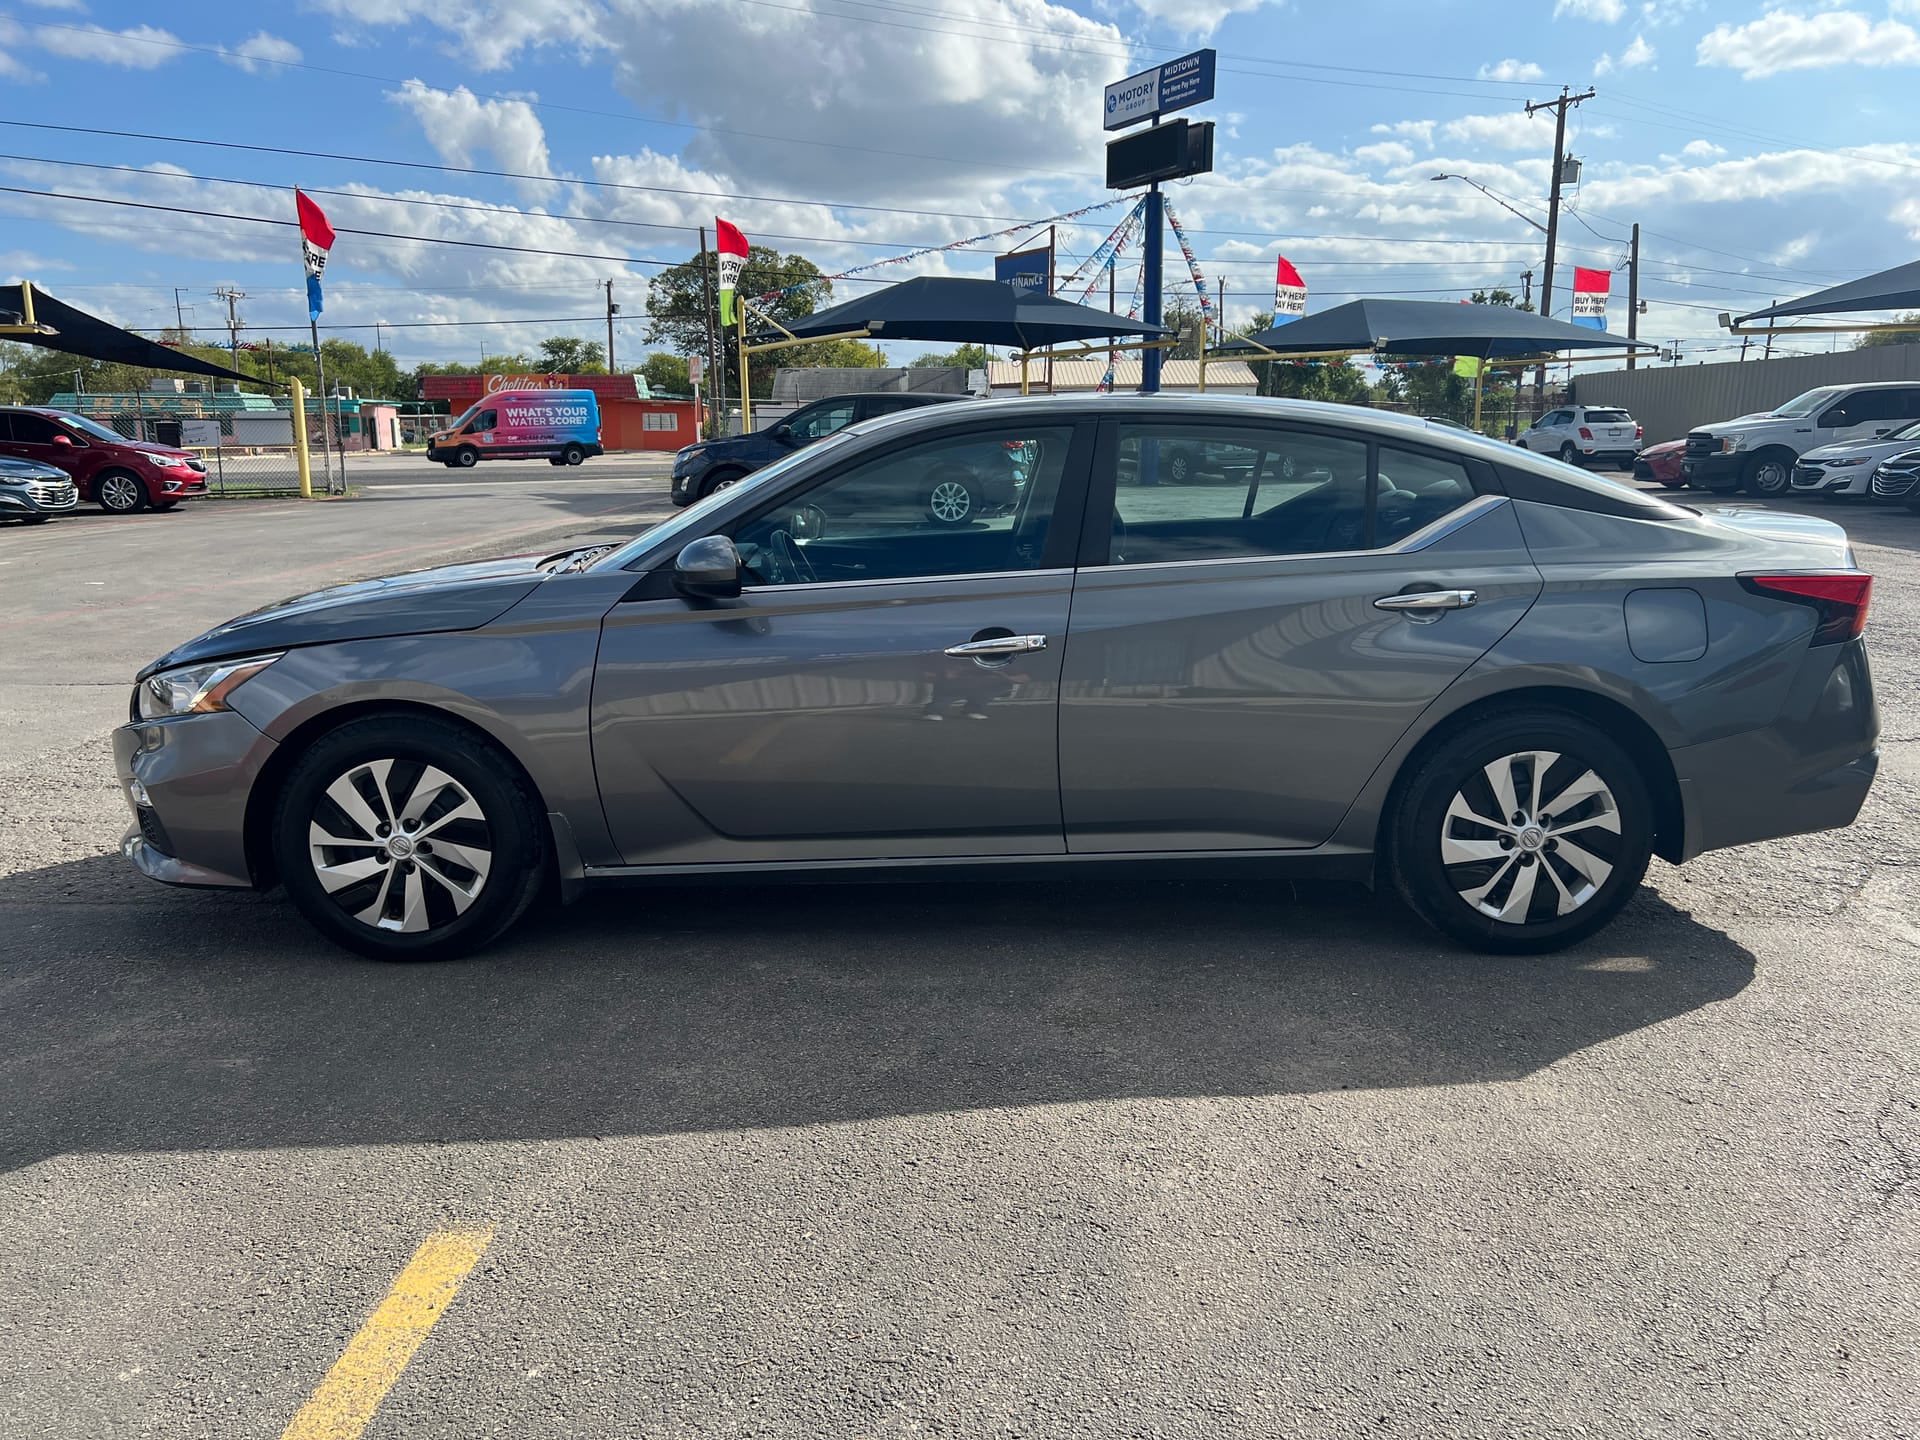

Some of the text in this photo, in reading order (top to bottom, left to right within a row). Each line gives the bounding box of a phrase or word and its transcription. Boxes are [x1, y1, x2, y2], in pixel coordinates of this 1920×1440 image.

[1164, 56, 1200, 77] MIDTOWN
[1118, 81, 1155, 104] MOTORY
[1125, 99, 1146, 111] GROUP
[1574, 296, 1589, 304] BUY
[1574, 305, 1588, 313] PAY
[488, 374, 542, 393] Chelitas
[505, 407, 588, 417] WHAT'S YOUR
[508, 416, 587, 426] WATER SCORE?
